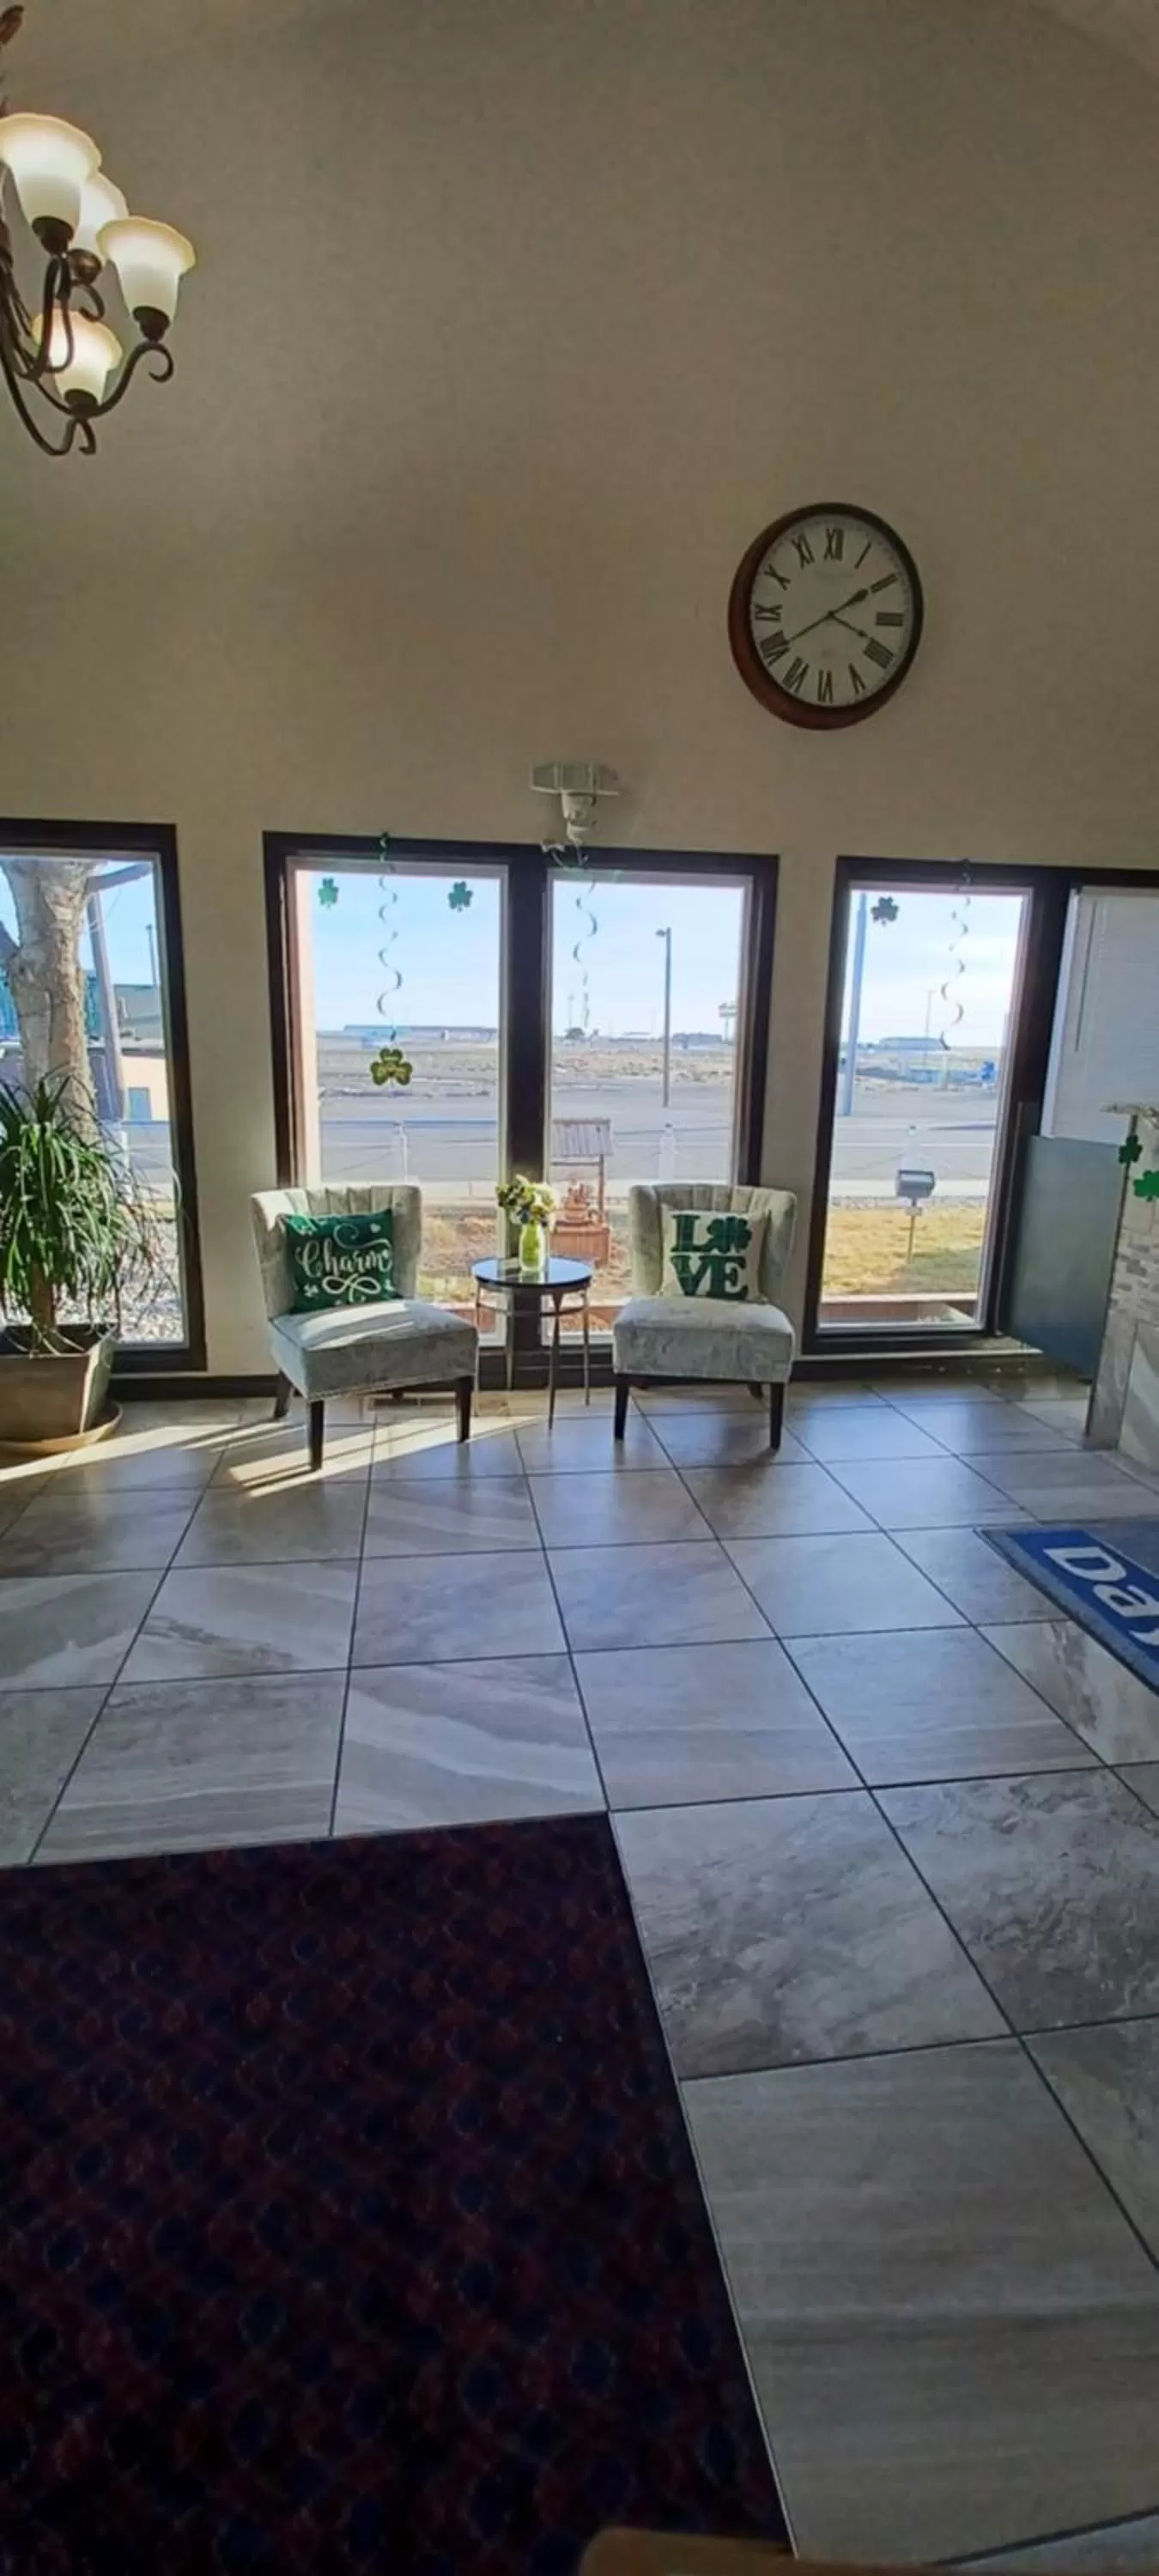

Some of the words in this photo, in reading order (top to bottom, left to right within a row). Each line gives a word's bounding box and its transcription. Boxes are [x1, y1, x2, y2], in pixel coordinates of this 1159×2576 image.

[791, 533, 815, 569] XI
[824, 528, 845, 561] XII
[854, 541, 872, 568] I
[764, 564, 791, 591] X
[870, 573, 898, 594] II
[755, 604, 783, 622] IX
[875, 611, 904, 627] III
[817, 669, 834, 703] VI
[847, 663, 866, 695] V
[295, 1237, 393, 1279] Charm
